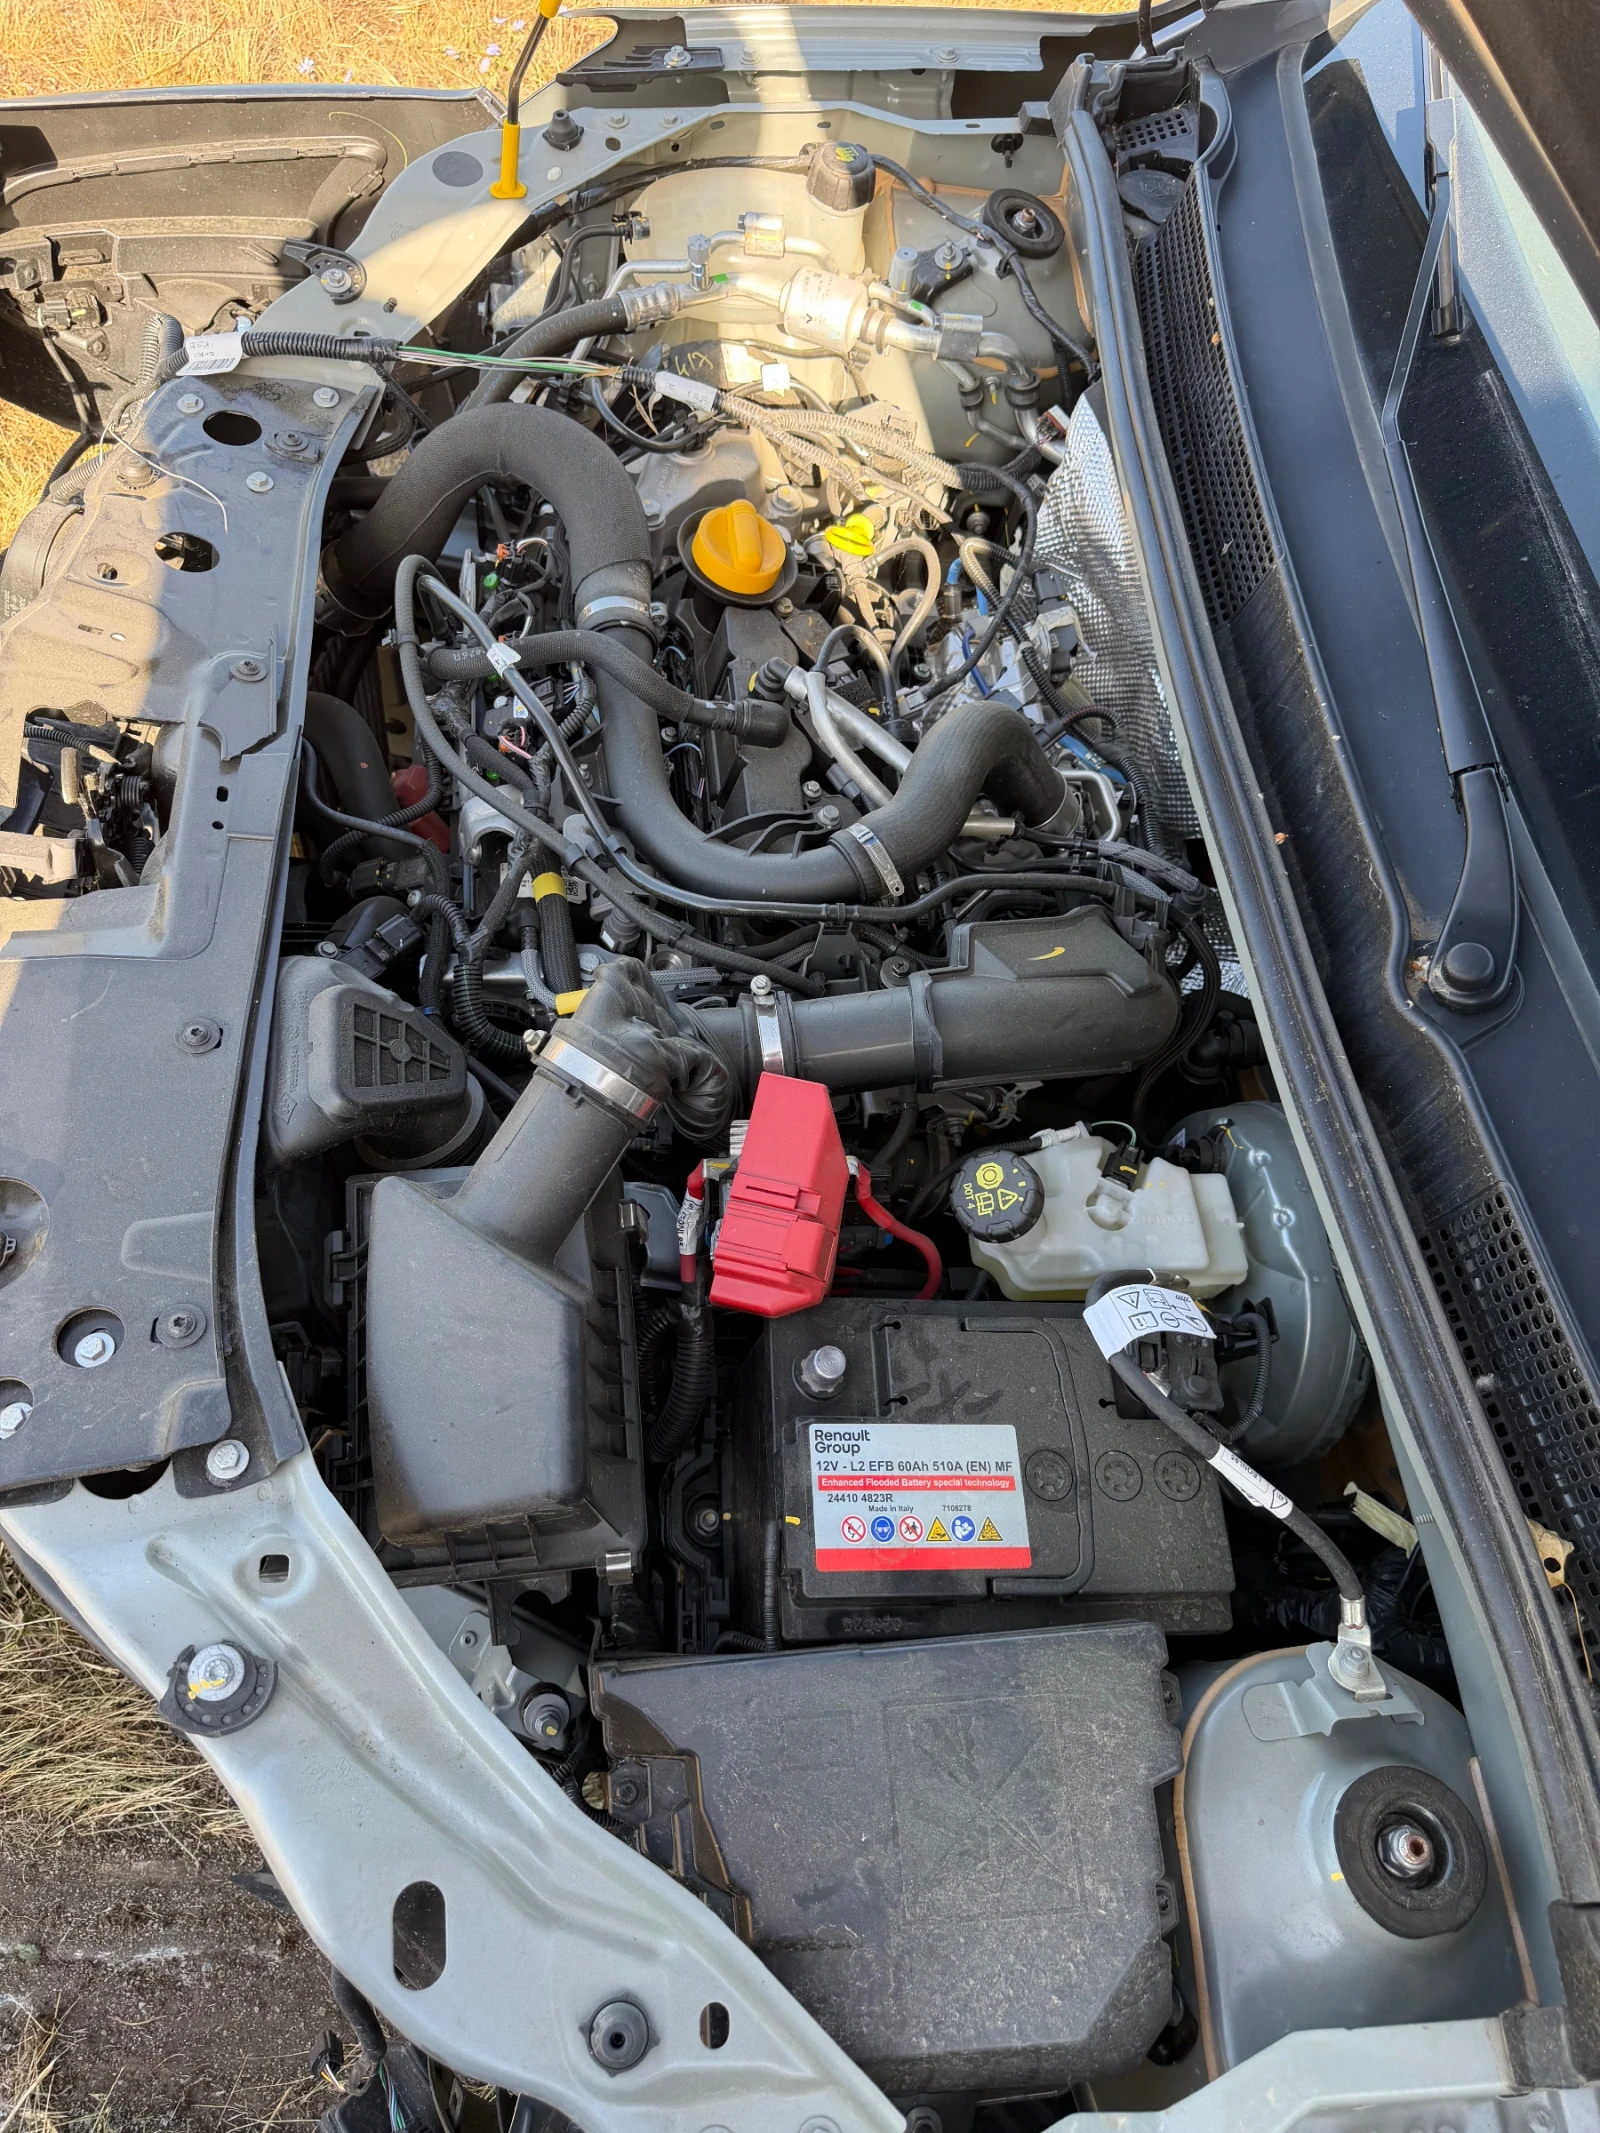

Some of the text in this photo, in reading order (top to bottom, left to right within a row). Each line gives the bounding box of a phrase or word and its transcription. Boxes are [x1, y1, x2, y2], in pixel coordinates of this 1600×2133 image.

[963, 1182, 975, 1200] DOT
[814, 1429, 870, 1441] Renault
[814, 1441, 860, 1456] Group
[816, 1460, 839, 1472] 12V
[850, 1460, 865, 1472] L2
[869, 1460, 894, 1472] EFB
[898, 1460, 929, 1472] 60Ah
[932, 1460, 963, 1472] 510A
[966, 1460, 991, 1474] (EN)
[995, 1461, 1013, 1472] MF
[821, 1478, 1010, 1488] Enhanced Flooded Battery special technology
[827, 1493, 894, 1503] 24410 4823R
[898, 1505, 914, 1513] Italy
